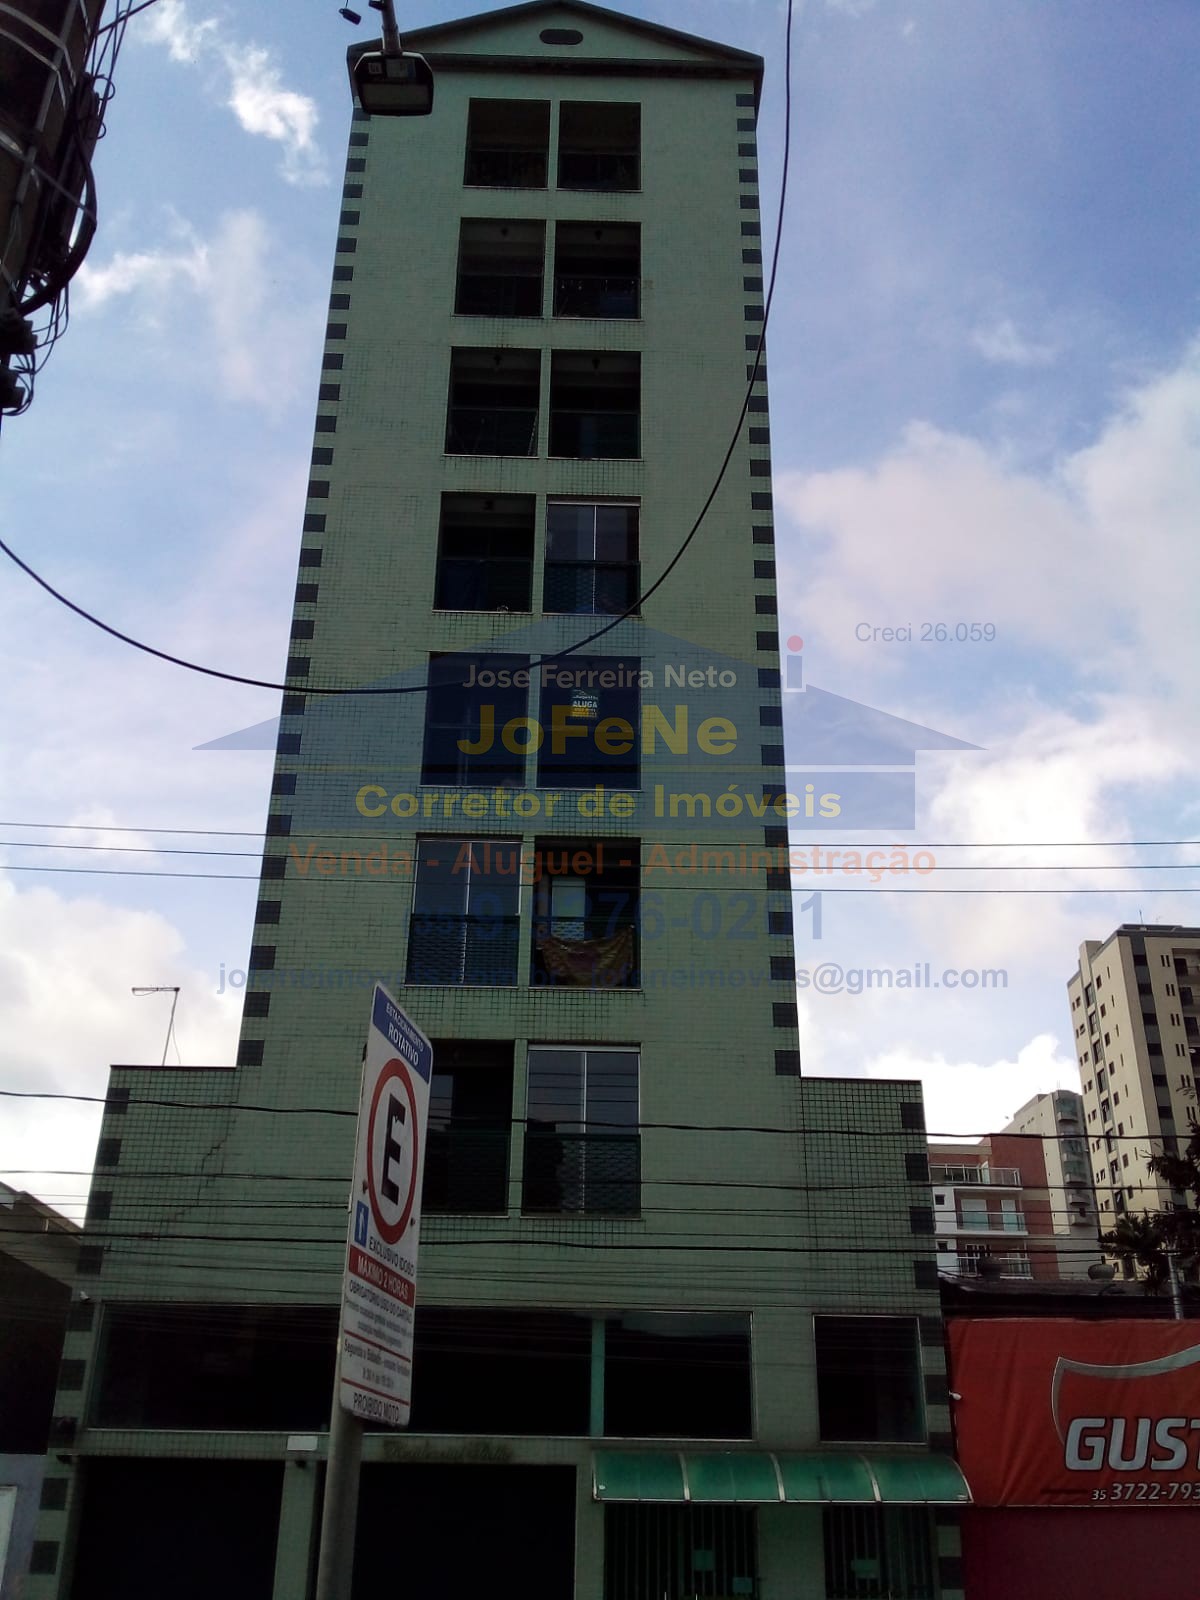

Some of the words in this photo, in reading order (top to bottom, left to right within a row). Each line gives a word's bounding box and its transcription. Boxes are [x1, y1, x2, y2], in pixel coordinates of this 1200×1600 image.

[388, 1025, 419, 1066] ROTATIVO
[381, 1093, 406, 1206] E
[369, 1236, 398, 1268] EXCLUSIVO
[357, 1255, 383, 1285] MÁXIMO
[383, 1271, 388, 1289] 2
[388, 1278, 409, 1300] HORAS
[353, 1392, 383, 1417] PROIBIDO
[1065, 1417, 1200, 1471] GUS
[1092, 1489, 1107, 1500] 35
